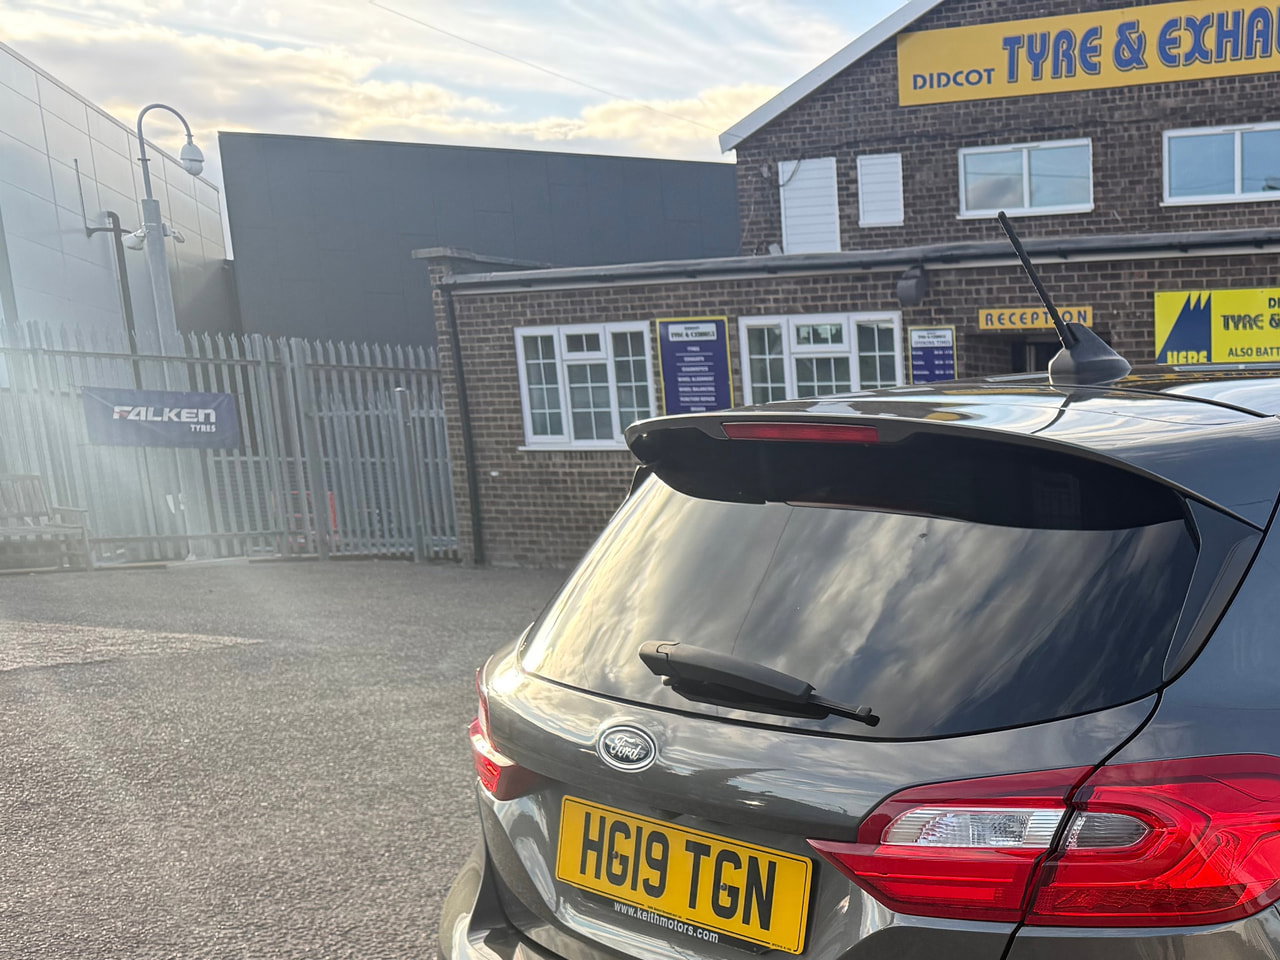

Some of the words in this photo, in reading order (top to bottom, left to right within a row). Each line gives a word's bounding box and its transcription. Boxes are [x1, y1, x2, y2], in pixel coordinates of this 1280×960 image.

[912, 68, 995, 90] DIDCOT
[1002, 26, 1102, 83] TYRE
[1113, 20, 1146, 71] &
[985, 310, 1088, 326] RECEPTON
[1221, 313, 1264, 331] TYRE
[1228, 346, 1253, 358] ALSO
[113, 406, 216, 422] FALKEN
[190, 424, 216, 432] TYRES
[610, 735, 642, 760] Ford
[579, 811, 670, 898] HG19
[685, 839, 777, 931] TGN
[614, 902, 719, 943] www.keithmotors.com
